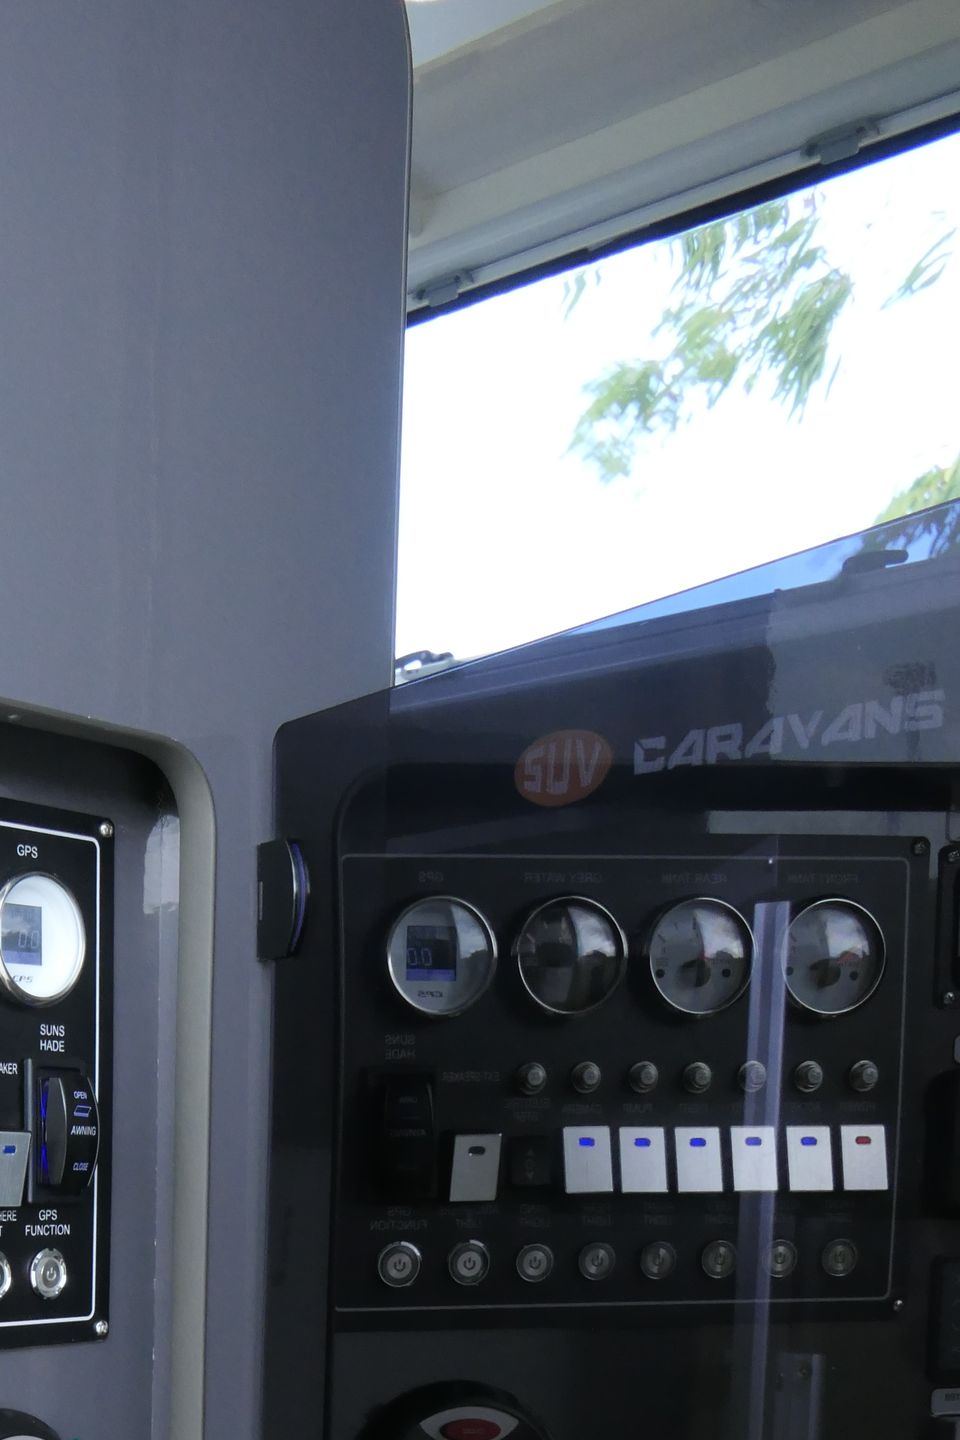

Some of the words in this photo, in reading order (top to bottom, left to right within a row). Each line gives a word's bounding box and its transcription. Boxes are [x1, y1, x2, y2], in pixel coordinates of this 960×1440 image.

[520, 734, 607, 799] SUV
[634, 689, 946, 776] CARAVANS
[16, 844, 38, 859] GPS
[40, 1024, 65, 1037] SUNS
[40, 1040, 65, 1052] HADE
[70, 1125, 97, 1137] AWNING
[72, 1162, 89, 1171] CLOSE
[38, 1209, 58, 1221] GPS
[25, 1224, 71, 1237] FUNCTION
